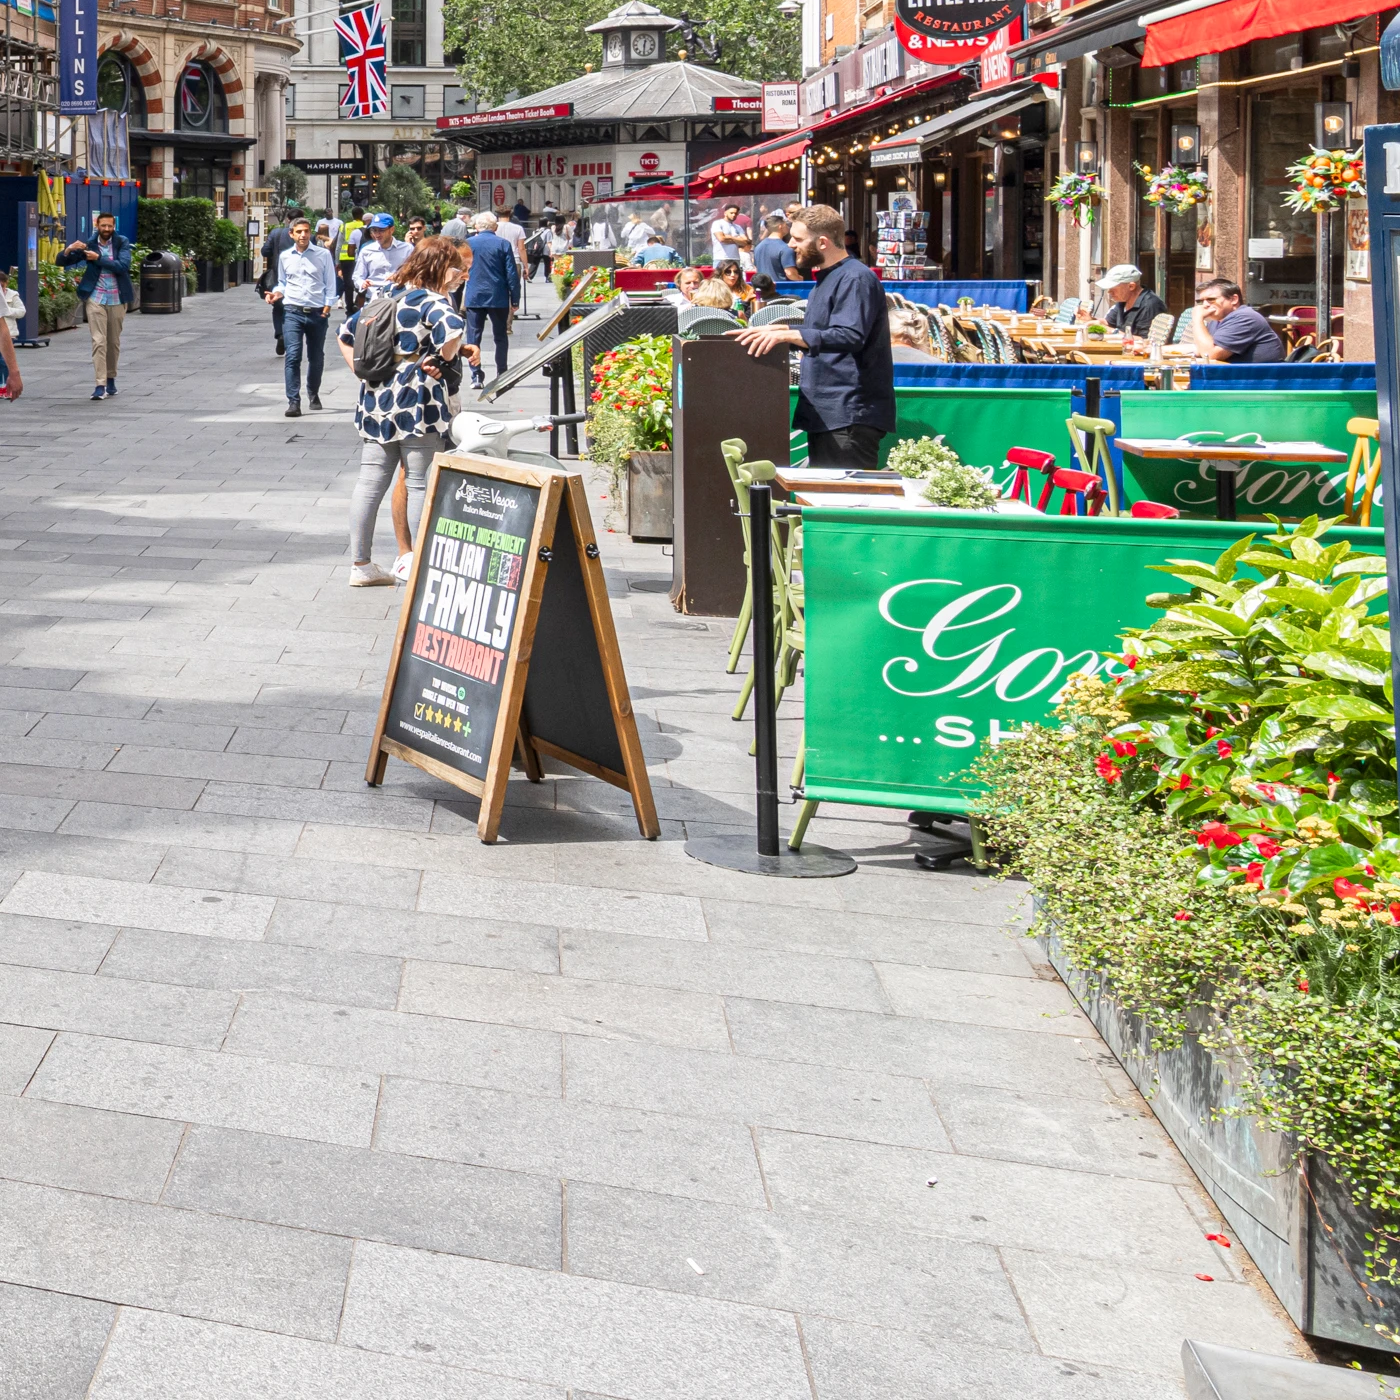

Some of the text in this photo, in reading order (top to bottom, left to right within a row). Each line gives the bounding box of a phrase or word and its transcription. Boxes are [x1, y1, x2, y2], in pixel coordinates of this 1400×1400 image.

[913, 4, 1013, 32] RESTAURANT
[908, 34, 923, 49] &
[766, 89, 797, 97] RISTORANTE
[448, 118, 460, 126] TKTS
[471, 114, 488, 123] Official
[488, 112, 506, 121] London
[506, 110, 524, 120] Theatre
[524, 109, 540, 118] Ticket
[540, 107, 555, 116] Booth
[306, 162, 353, 170] HAMPSHIRE
[526, 153, 567, 177] tkts
[463, 503, 504, 521] Italian Restaurant
[490, 488, 519, 514] Vespa
[435, 517, 526, 555] AUTHENTIC INDEPENDENT
[429, 534, 486, 581] ITALIAN
[418, 568, 516, 650] FAMILY
[412, 622, 505, 685] RESTAURANT
[456, 701, 470, 716] TABLE
[400, 720, 482, 764] www.vespaitalianrestaurant.com
